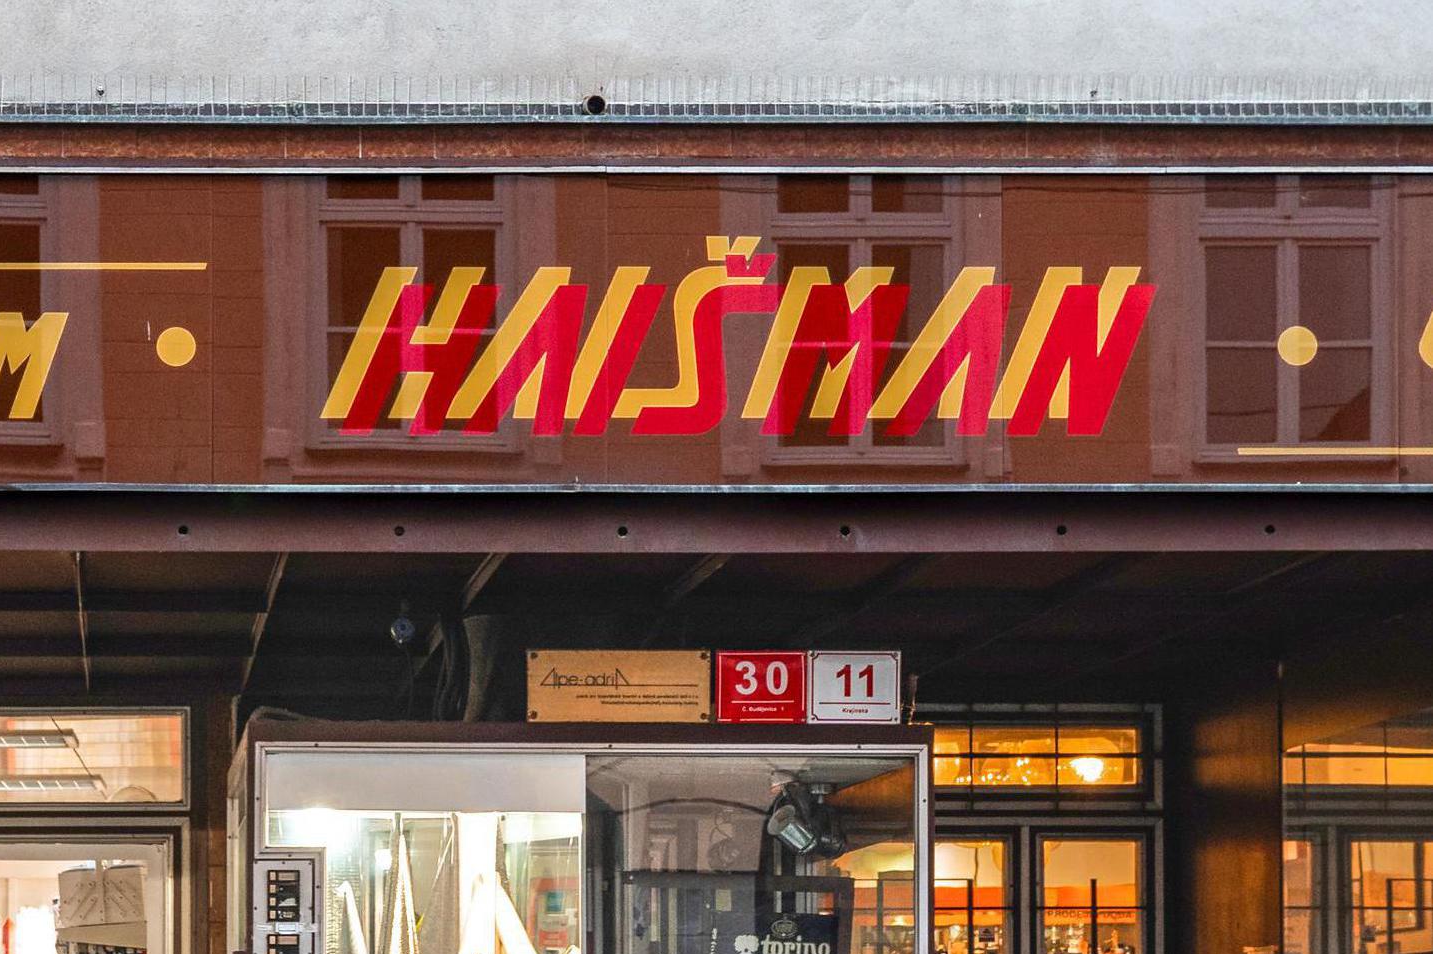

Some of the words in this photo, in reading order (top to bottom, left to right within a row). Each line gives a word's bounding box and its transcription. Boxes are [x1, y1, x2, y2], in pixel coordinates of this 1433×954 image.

[319, 235, 1156, 436] HAIŠMAN
[734, 660, 789, 696] 30
[835, 664, 874, 697] 11
